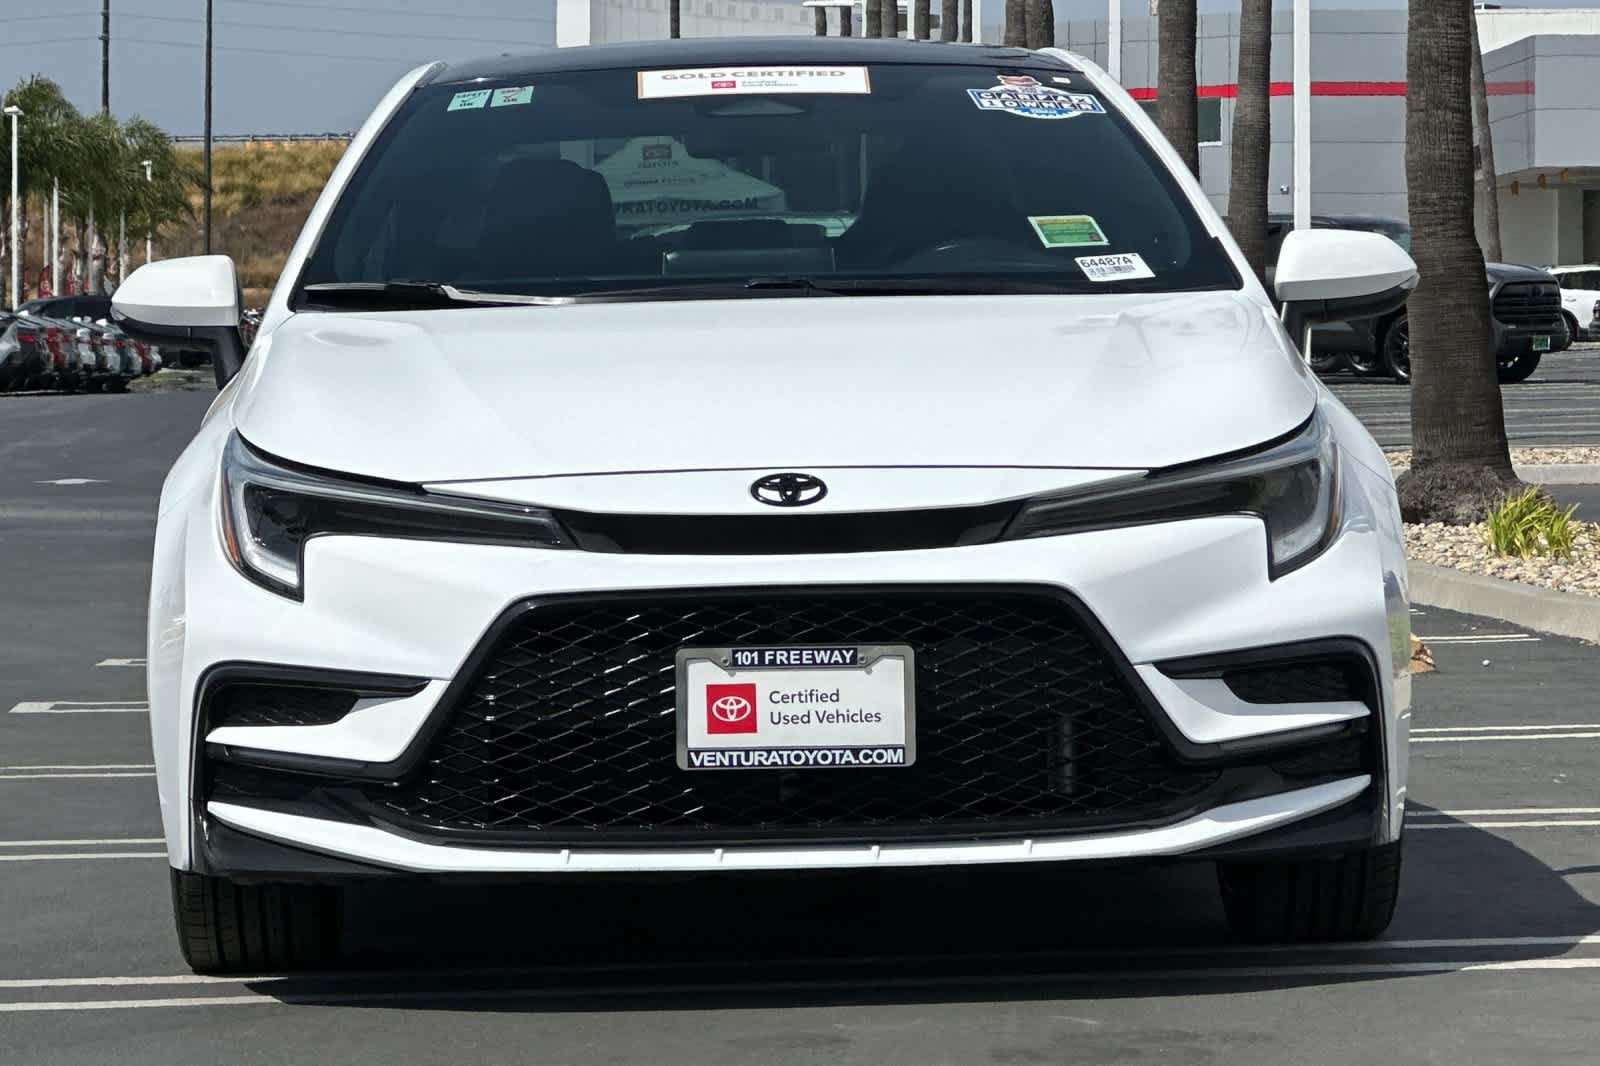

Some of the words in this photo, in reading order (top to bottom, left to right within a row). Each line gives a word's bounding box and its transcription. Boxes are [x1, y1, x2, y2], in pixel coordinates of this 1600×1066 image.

[661, 71, 727, 81] GOLD
[731, 70, 847, 78] CERTIFIED
[1080, 255, 1134, 268] 64487A
[734, 650, 760, 665] 101
[764, 649, 855, 665] FREEWAY
[768, 688, 841, 704] Certified
[769, 710, 811, 725] Used
[814, 709, 882, 725] Vehicles
[689, 748, 904, 767] VENTURATOYOTA.COM
